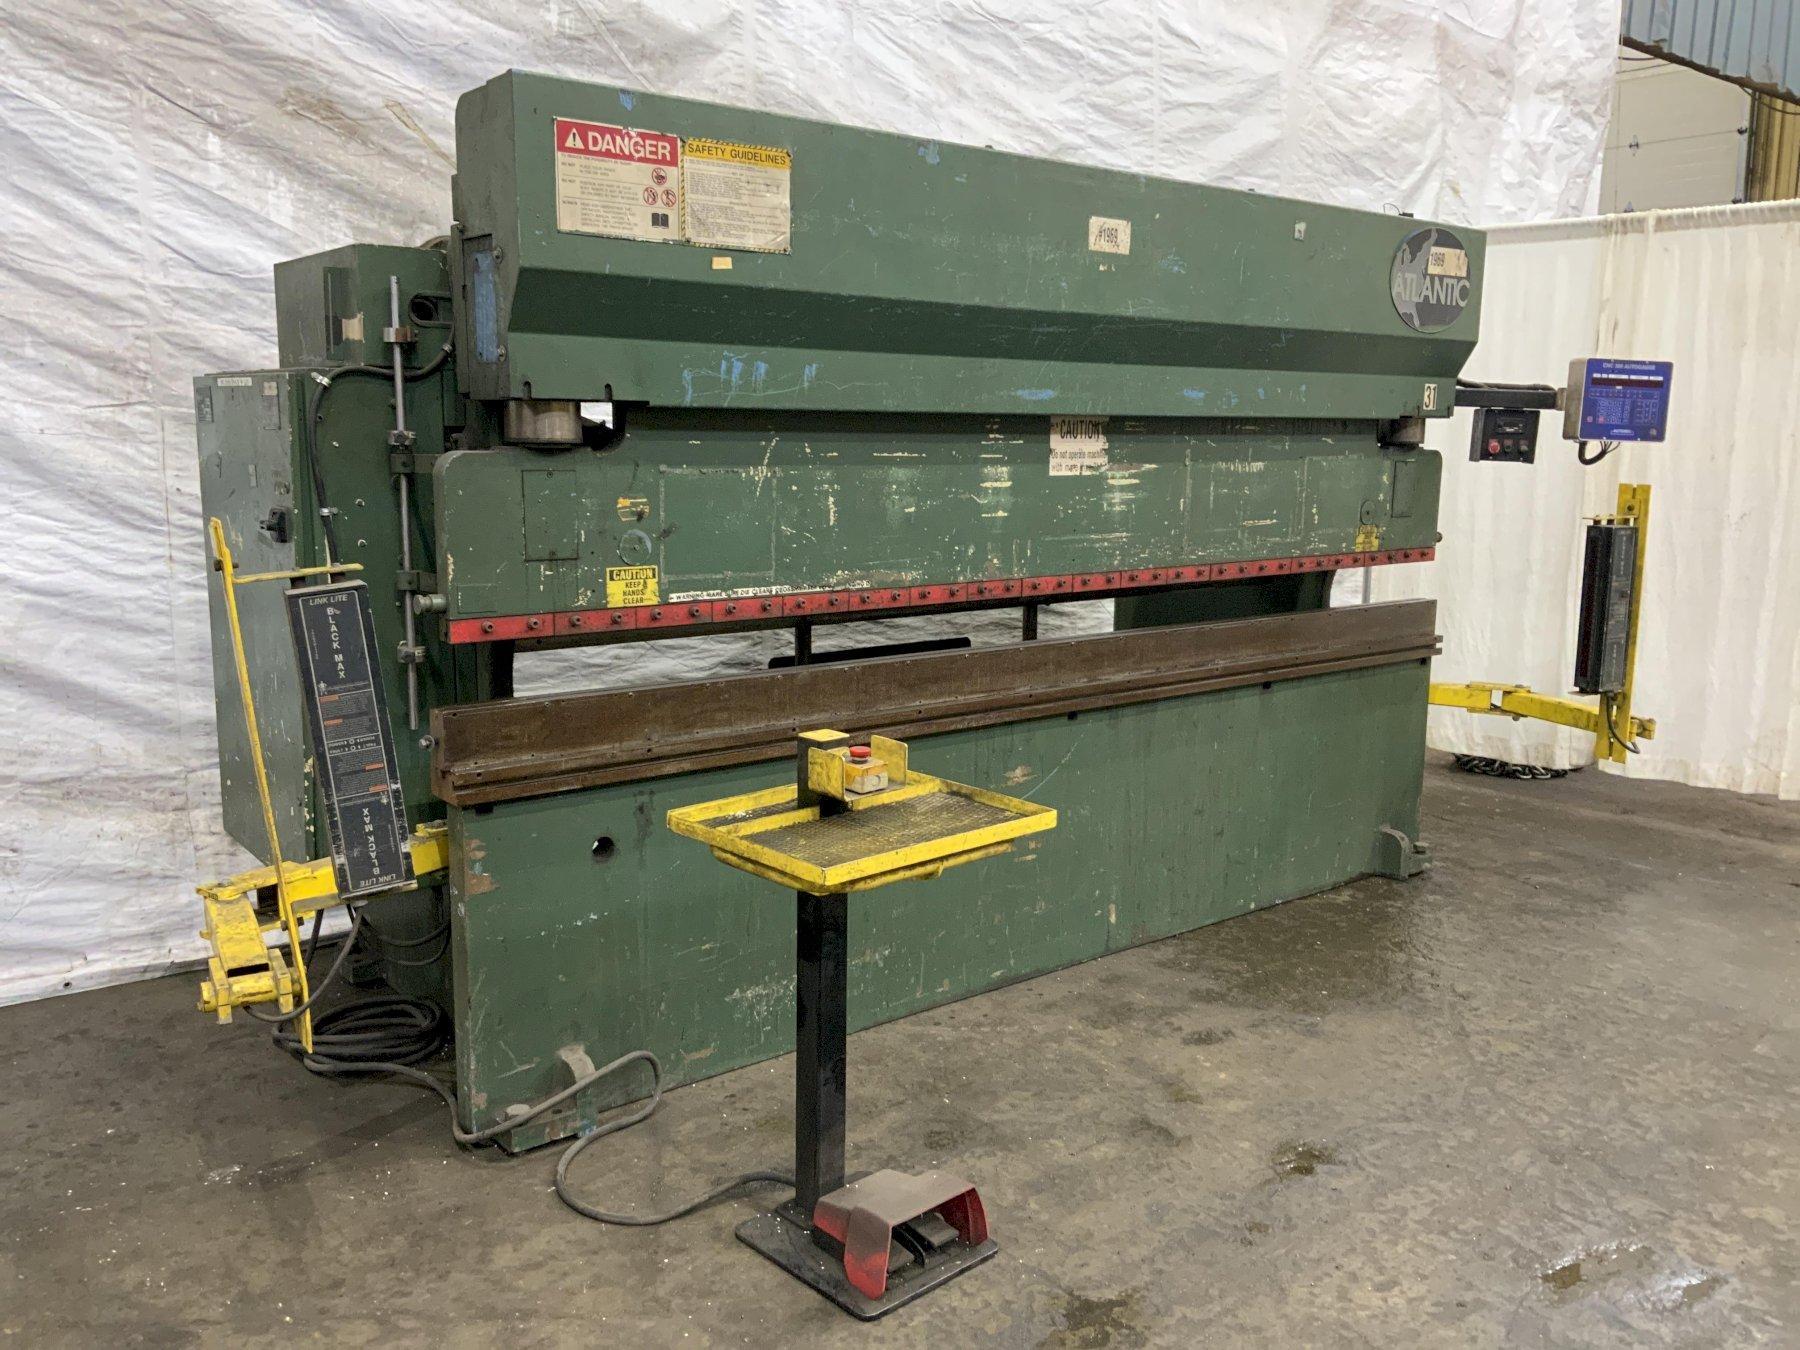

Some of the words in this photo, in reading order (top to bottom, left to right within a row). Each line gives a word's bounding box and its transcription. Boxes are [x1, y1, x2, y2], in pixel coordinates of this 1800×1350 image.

[588, 131, 671, 161] DANGER
[688, 143, 726, 157] SAFETY
[730, 149, 786, 165] GUIDELINES
[1392, 272, 1471, 307] ATLANTIC
[1424, 385, 1438, 409] 31
[1060, 419, 1100, 440] CAUTION
[613, 568, 653, 580] CAUTION
[309, 597, 328, 605] LINK
[330, 594, 348, 603] LITE
[676, 592, 705, 600] WARNING
[326, 607, 341, 650] BLACK
[334, 654, 346, 679] MAX
[362, 808, 374, 832] MAX
[367, 835, 380, 875] BLACK
[359, 877, 377, 887] LITE
[378, 873, 396, 884] LINK
